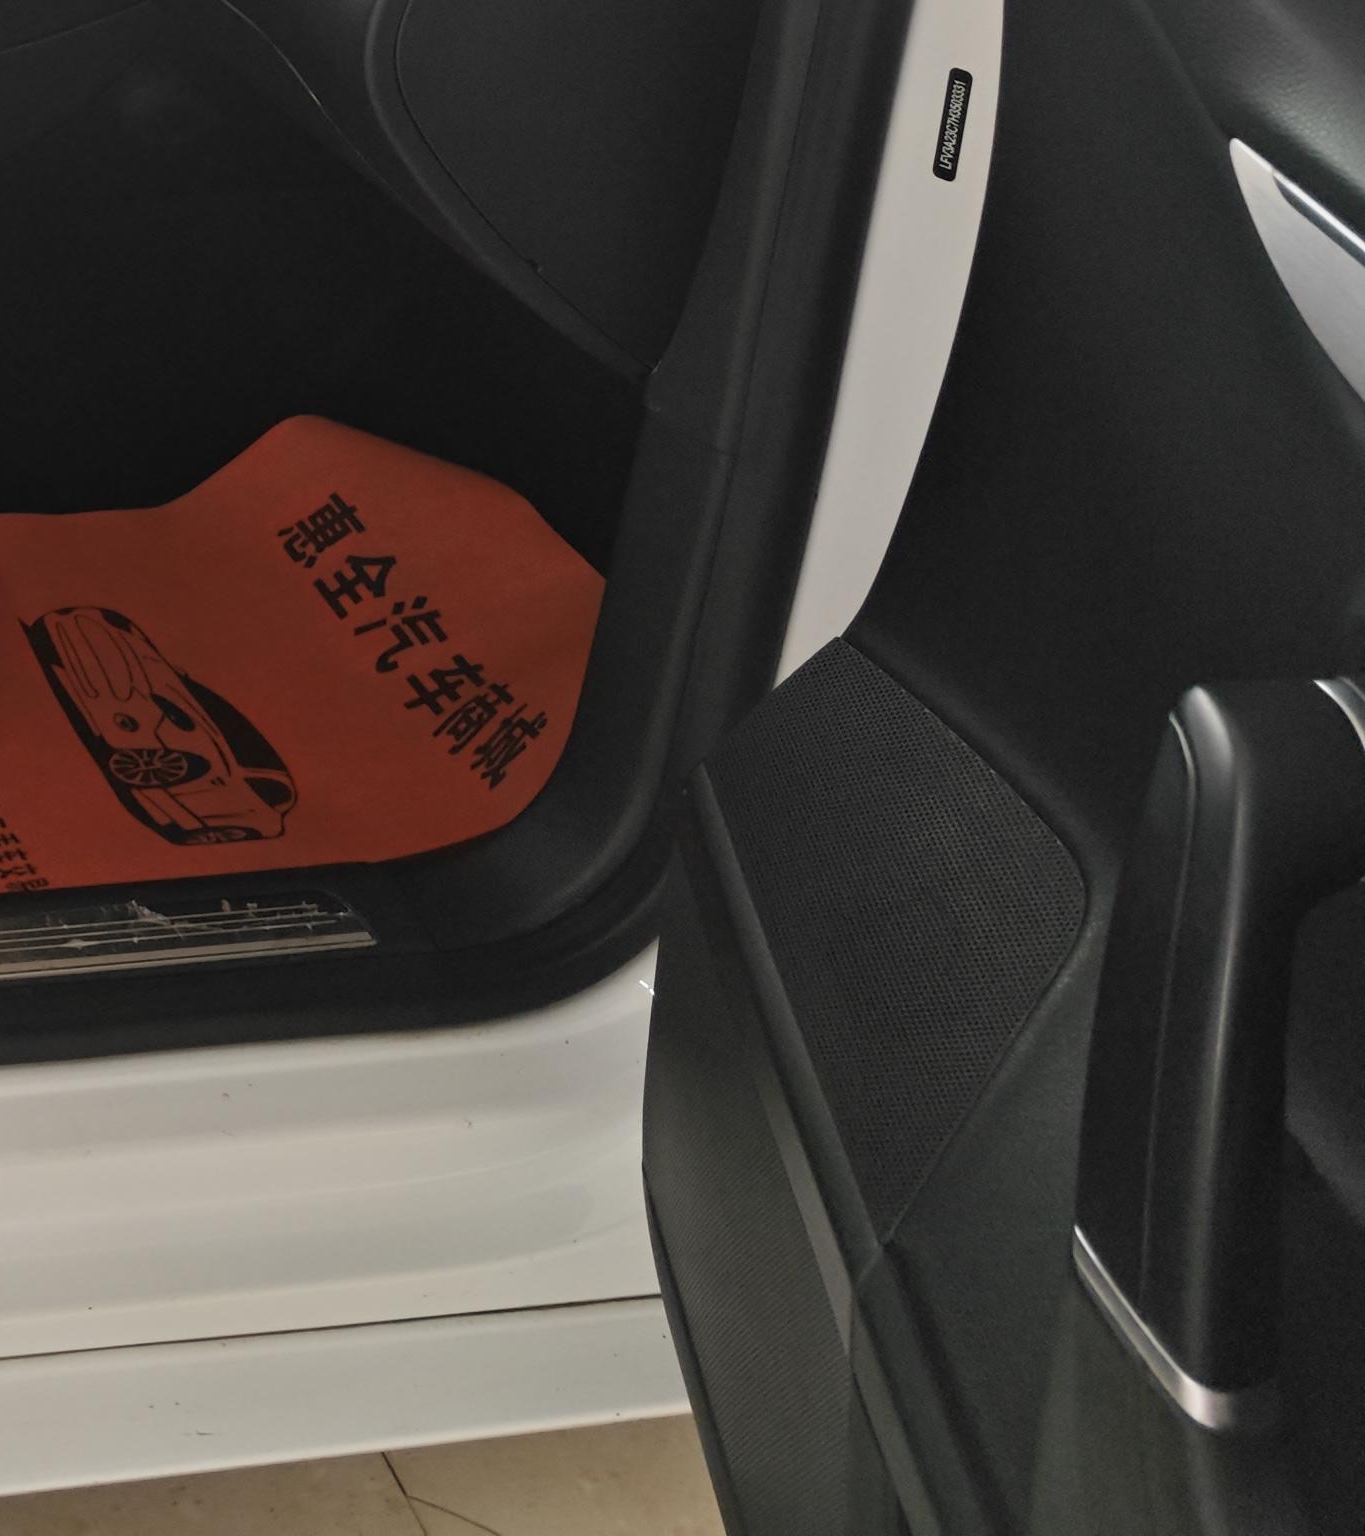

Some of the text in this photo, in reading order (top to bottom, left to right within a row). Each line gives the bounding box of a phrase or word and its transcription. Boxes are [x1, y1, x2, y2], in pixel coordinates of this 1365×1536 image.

[277, 492, 548, 790] 惠全汽车商城
